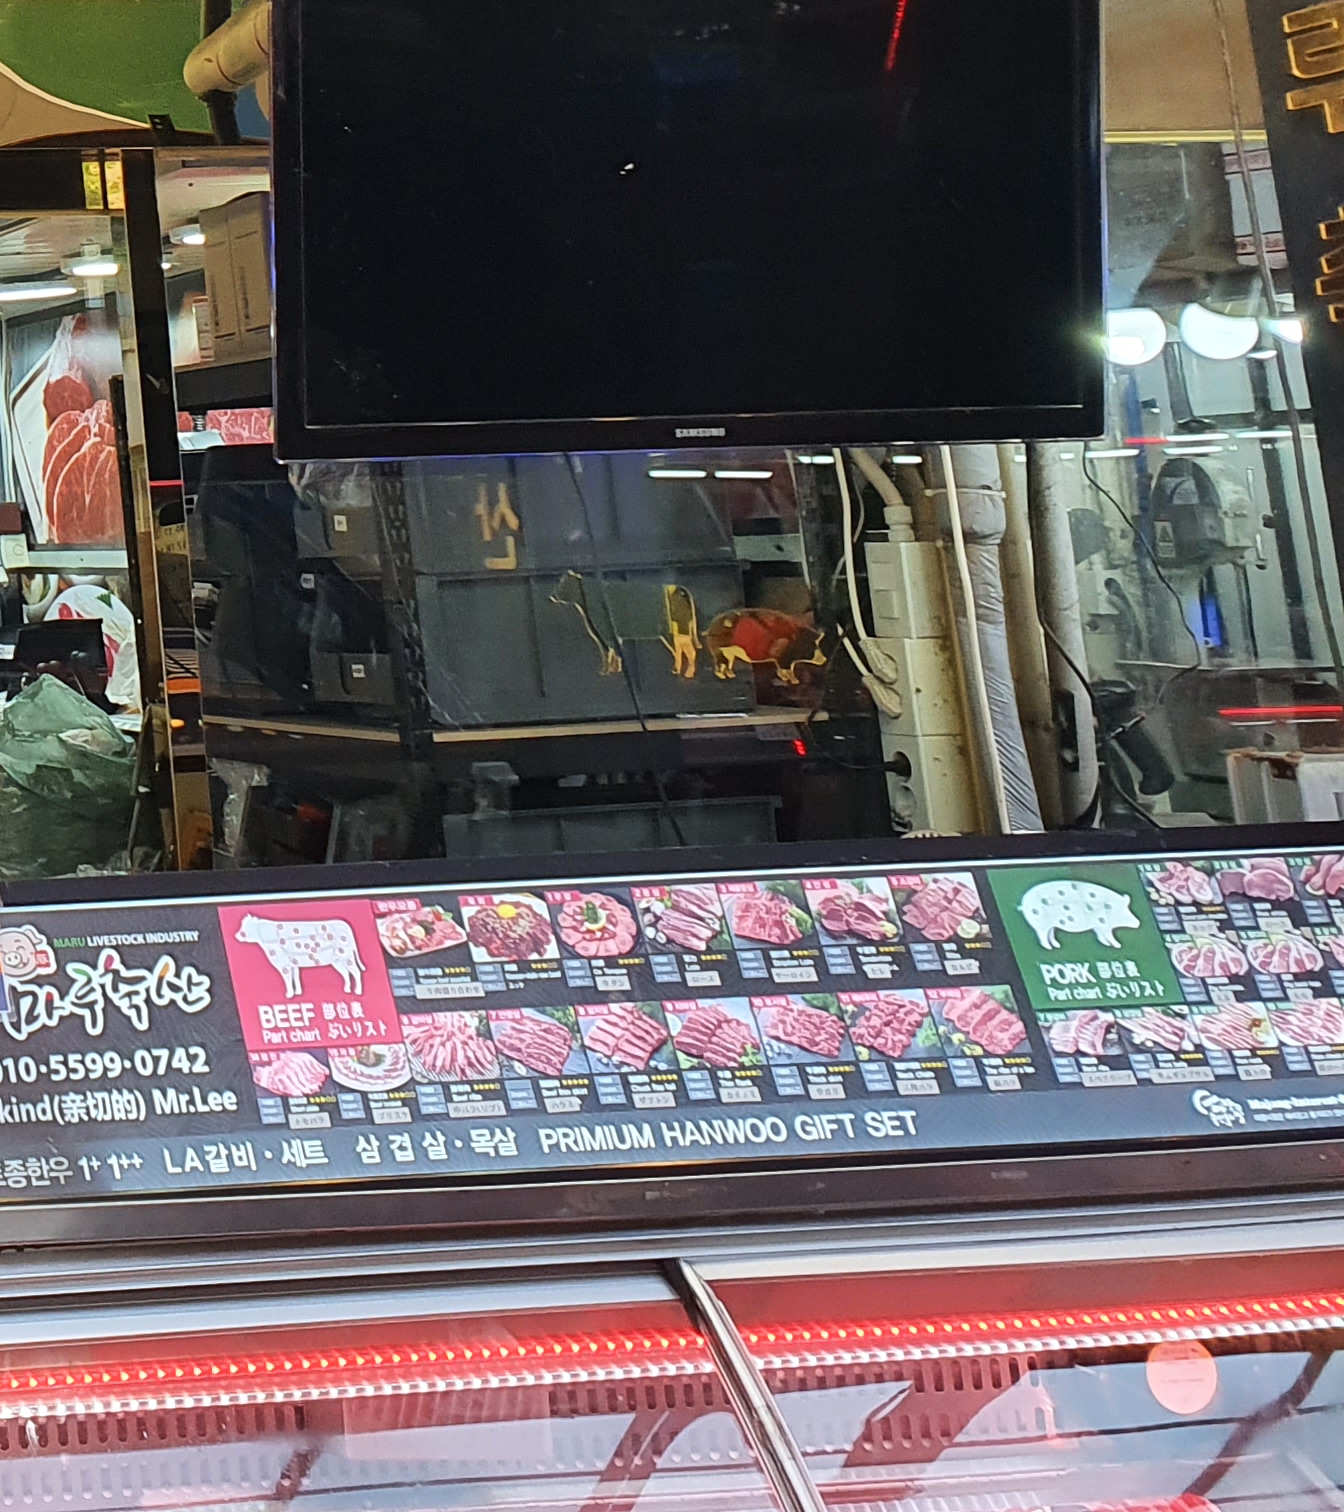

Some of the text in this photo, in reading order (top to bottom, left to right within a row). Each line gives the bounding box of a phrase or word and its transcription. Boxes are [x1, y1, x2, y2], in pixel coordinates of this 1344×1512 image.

[53, 930, 200, 948] MARU LIVESTOCK INDUSTRY
[1039, 961, 1141, 985] PORK 部位表
[1047, 986, 1072, 1001] Part
[1073, 985, 1103, 1000] chart
[257, 1001, 365, 1029] BEEF 部位表
[262, 1018, 388, 1044] Part chart ぶいリスト
[153, 1086, 238, 1115] Mr.Lee
[280, 1137, 329, 1168] 세트
[469, 1125, 519, 1158] 목살
[539, 1121, 656, 1154] PRIMIUM
[661, 1115, 788, 1147] HANWOO
[794, 1111, 856, 1141] GIFT
[864, 1110, 918, 1138] SET
